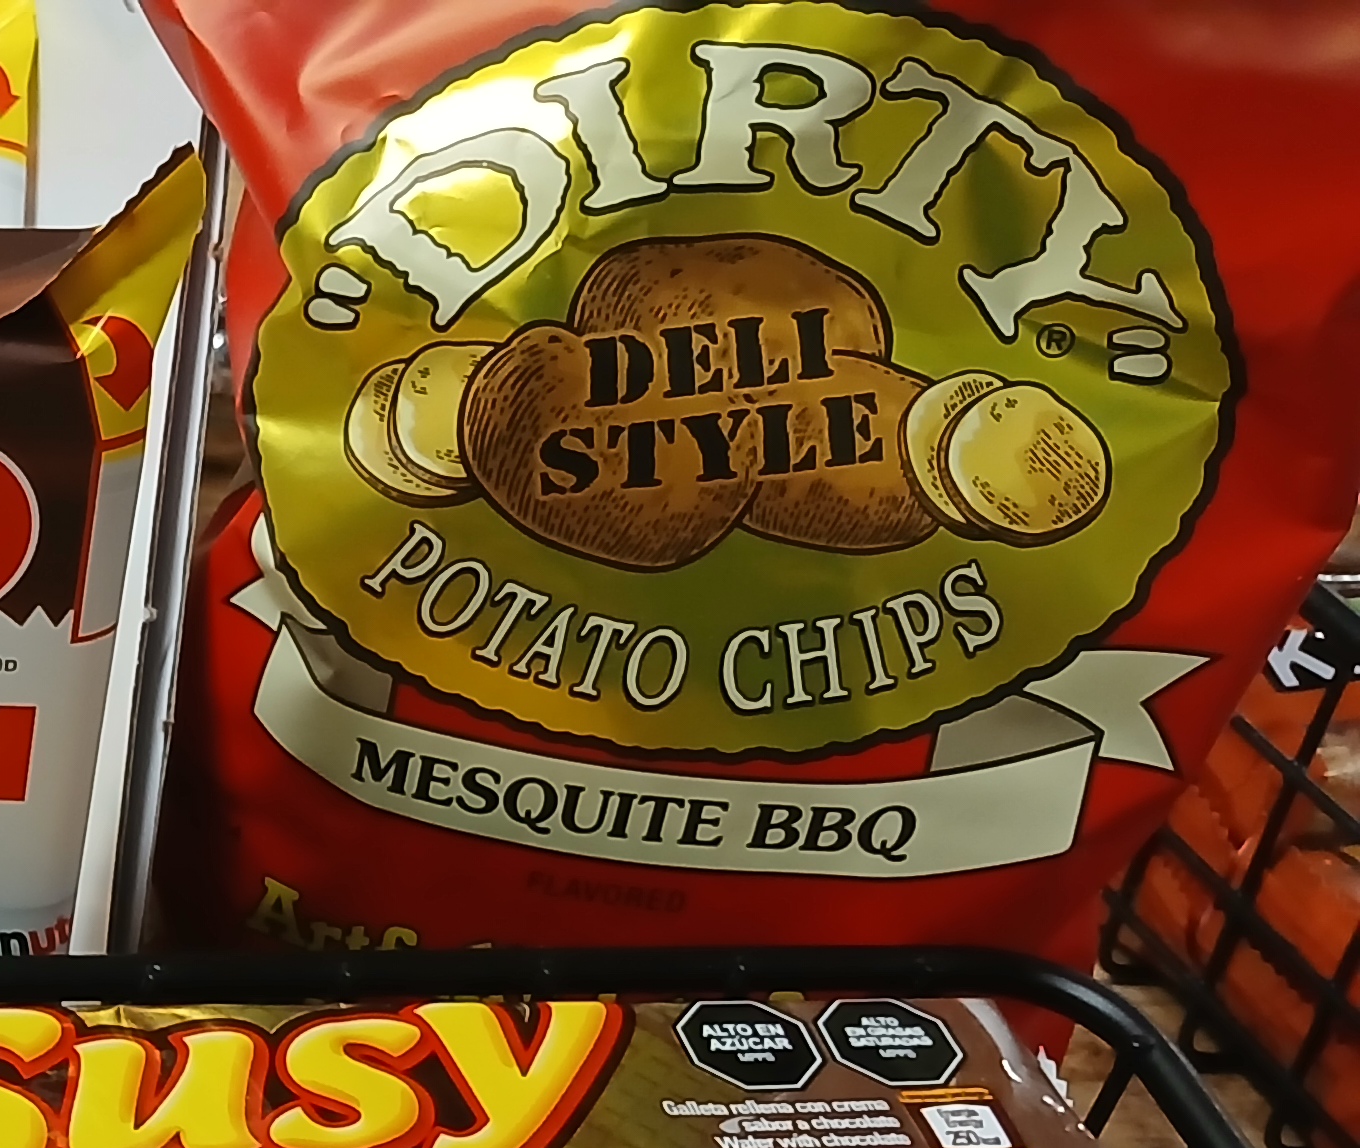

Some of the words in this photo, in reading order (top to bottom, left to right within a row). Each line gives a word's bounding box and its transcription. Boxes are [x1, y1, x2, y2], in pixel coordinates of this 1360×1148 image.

[584, 307, 836, 409] DELI
[537, 393, 885, 498] STYLE
[367, 523, 688, 708] POTATO
[720, 560, 1005, 716] CHIPS
[350, 737, 726, 850] MESQUITE
[744, 802, 918, 863] BBQ
[703, 1024, 752, 1038] ALTO
[756, 1023, 785, 1036] EN
[776, 1133, 821, 1148] with
[821, 1132, 912, 1148] chocolate
[795, 1101, 830, 1113] con
